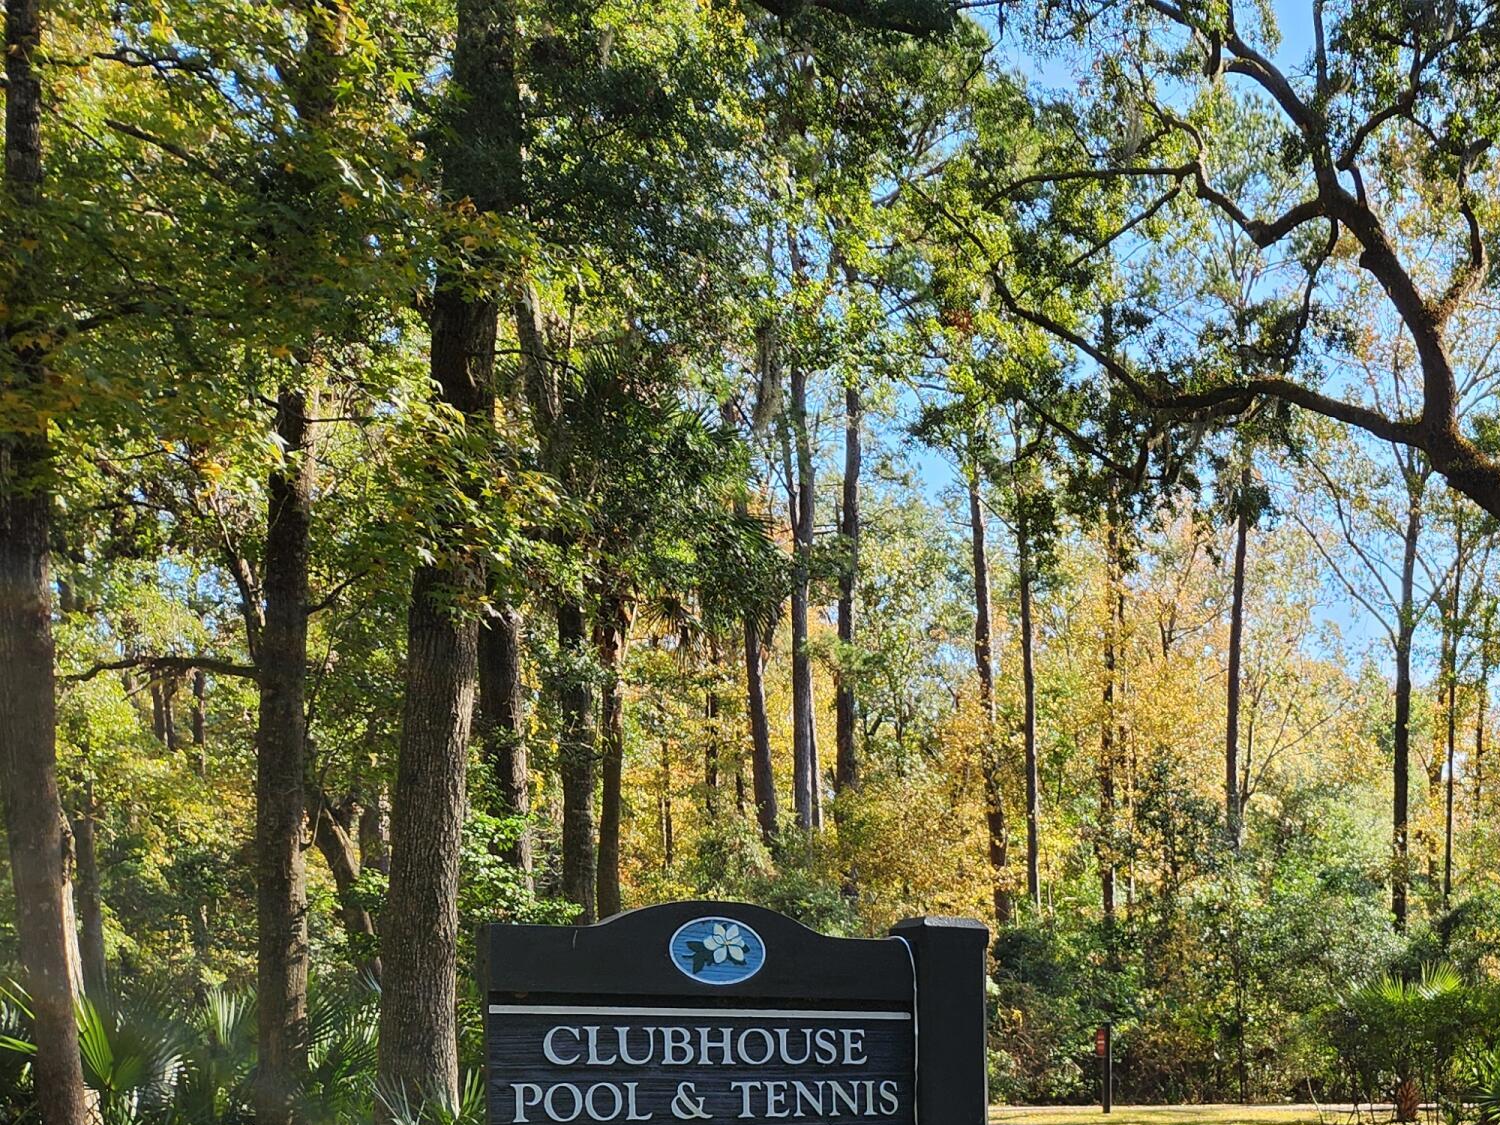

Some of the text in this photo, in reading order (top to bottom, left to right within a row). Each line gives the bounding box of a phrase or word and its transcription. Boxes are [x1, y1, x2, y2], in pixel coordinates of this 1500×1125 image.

[542, 1025, 868, 1066] CLUBHOUSE
[510, 1080, 900, 1123] POOL & TENNIS
